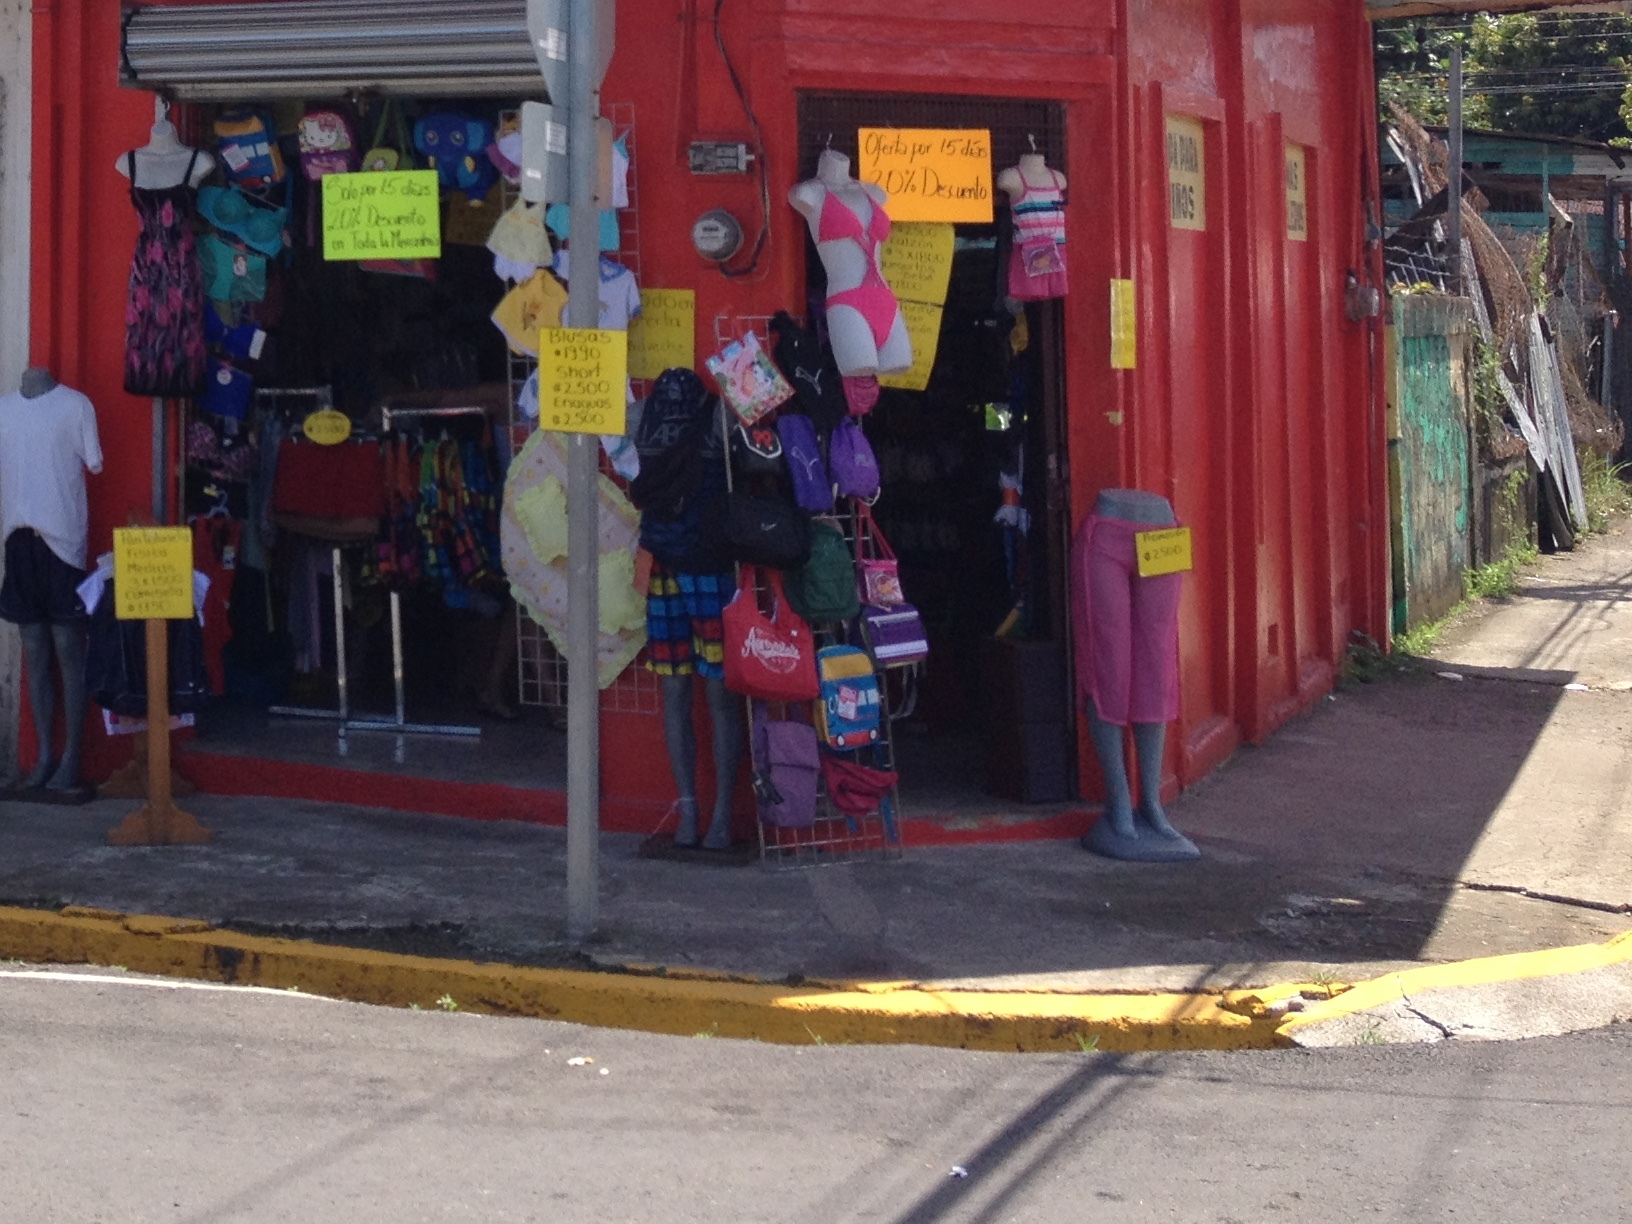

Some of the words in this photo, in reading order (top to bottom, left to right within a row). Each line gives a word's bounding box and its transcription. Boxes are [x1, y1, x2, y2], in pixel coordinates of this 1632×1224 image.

[865, 131, 908, 167] Oferta
[910, 142, 932, 164] por
[940, 138, 963, 156] 15
